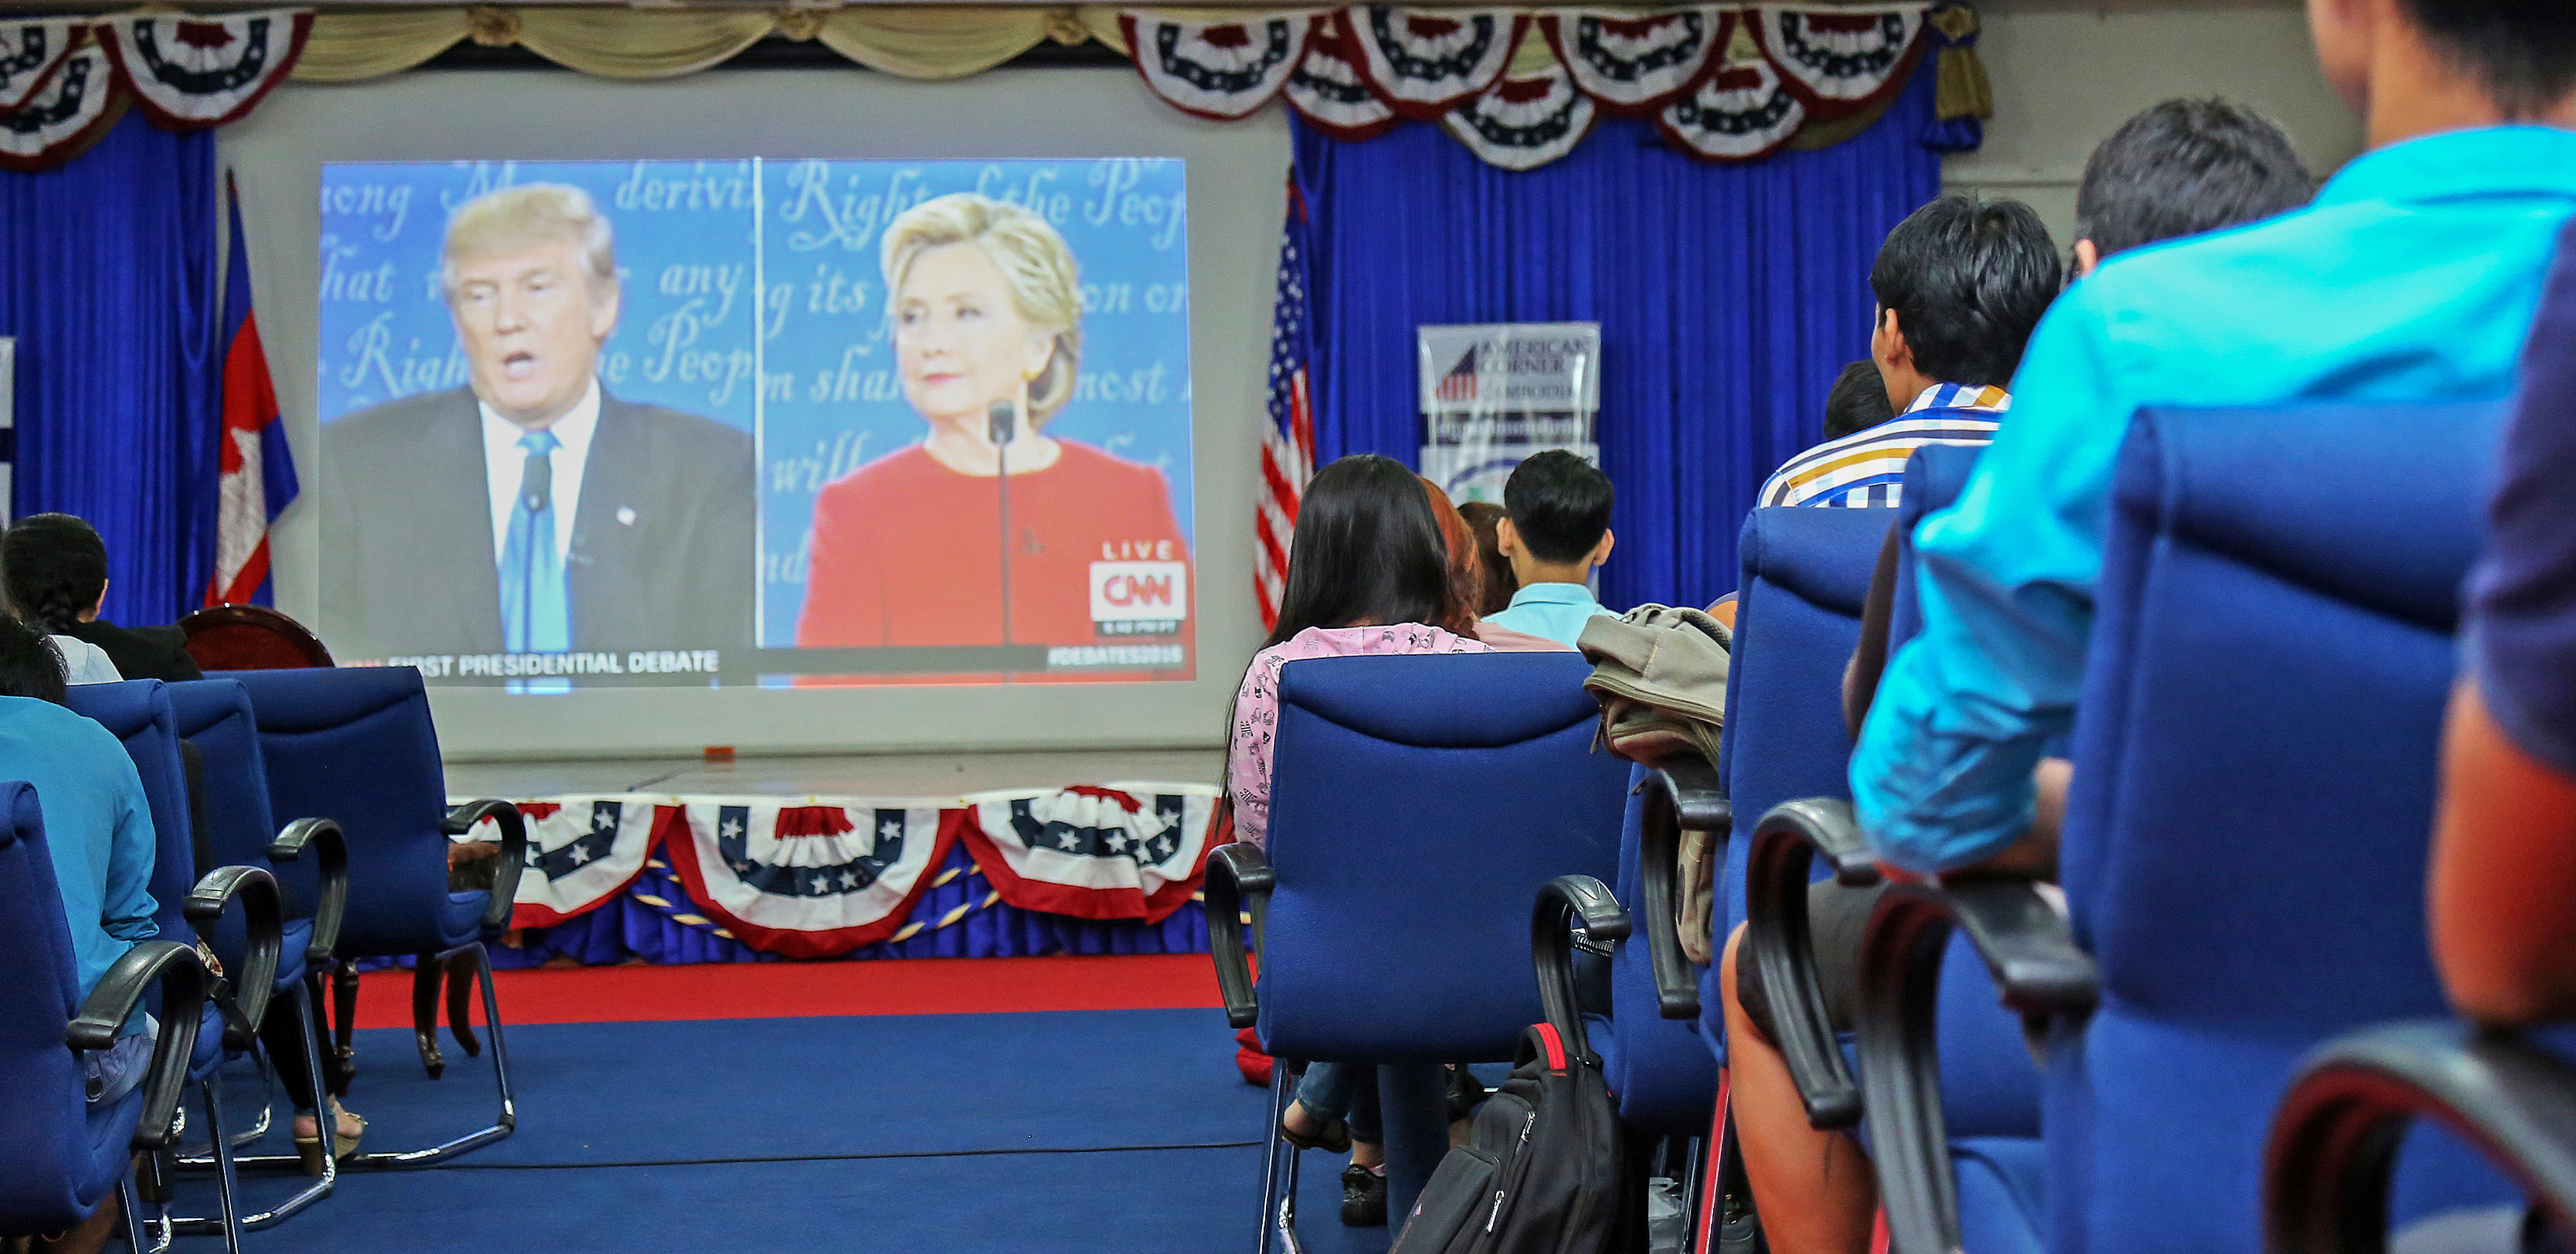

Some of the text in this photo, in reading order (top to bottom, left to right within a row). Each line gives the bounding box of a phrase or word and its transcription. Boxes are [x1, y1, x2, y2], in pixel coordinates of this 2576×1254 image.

[616, 161, 755, 211] derivi
[659, 264, 744, 328] any
[809, 263, 871, 314] its
[1102, 539, 1173, 561] LIVE
[1104, 575, 1172, 607] CNN
[458, 651, 625, 677] PRESIDENTIAL
[628, 649, 719, 675] DEBATE
